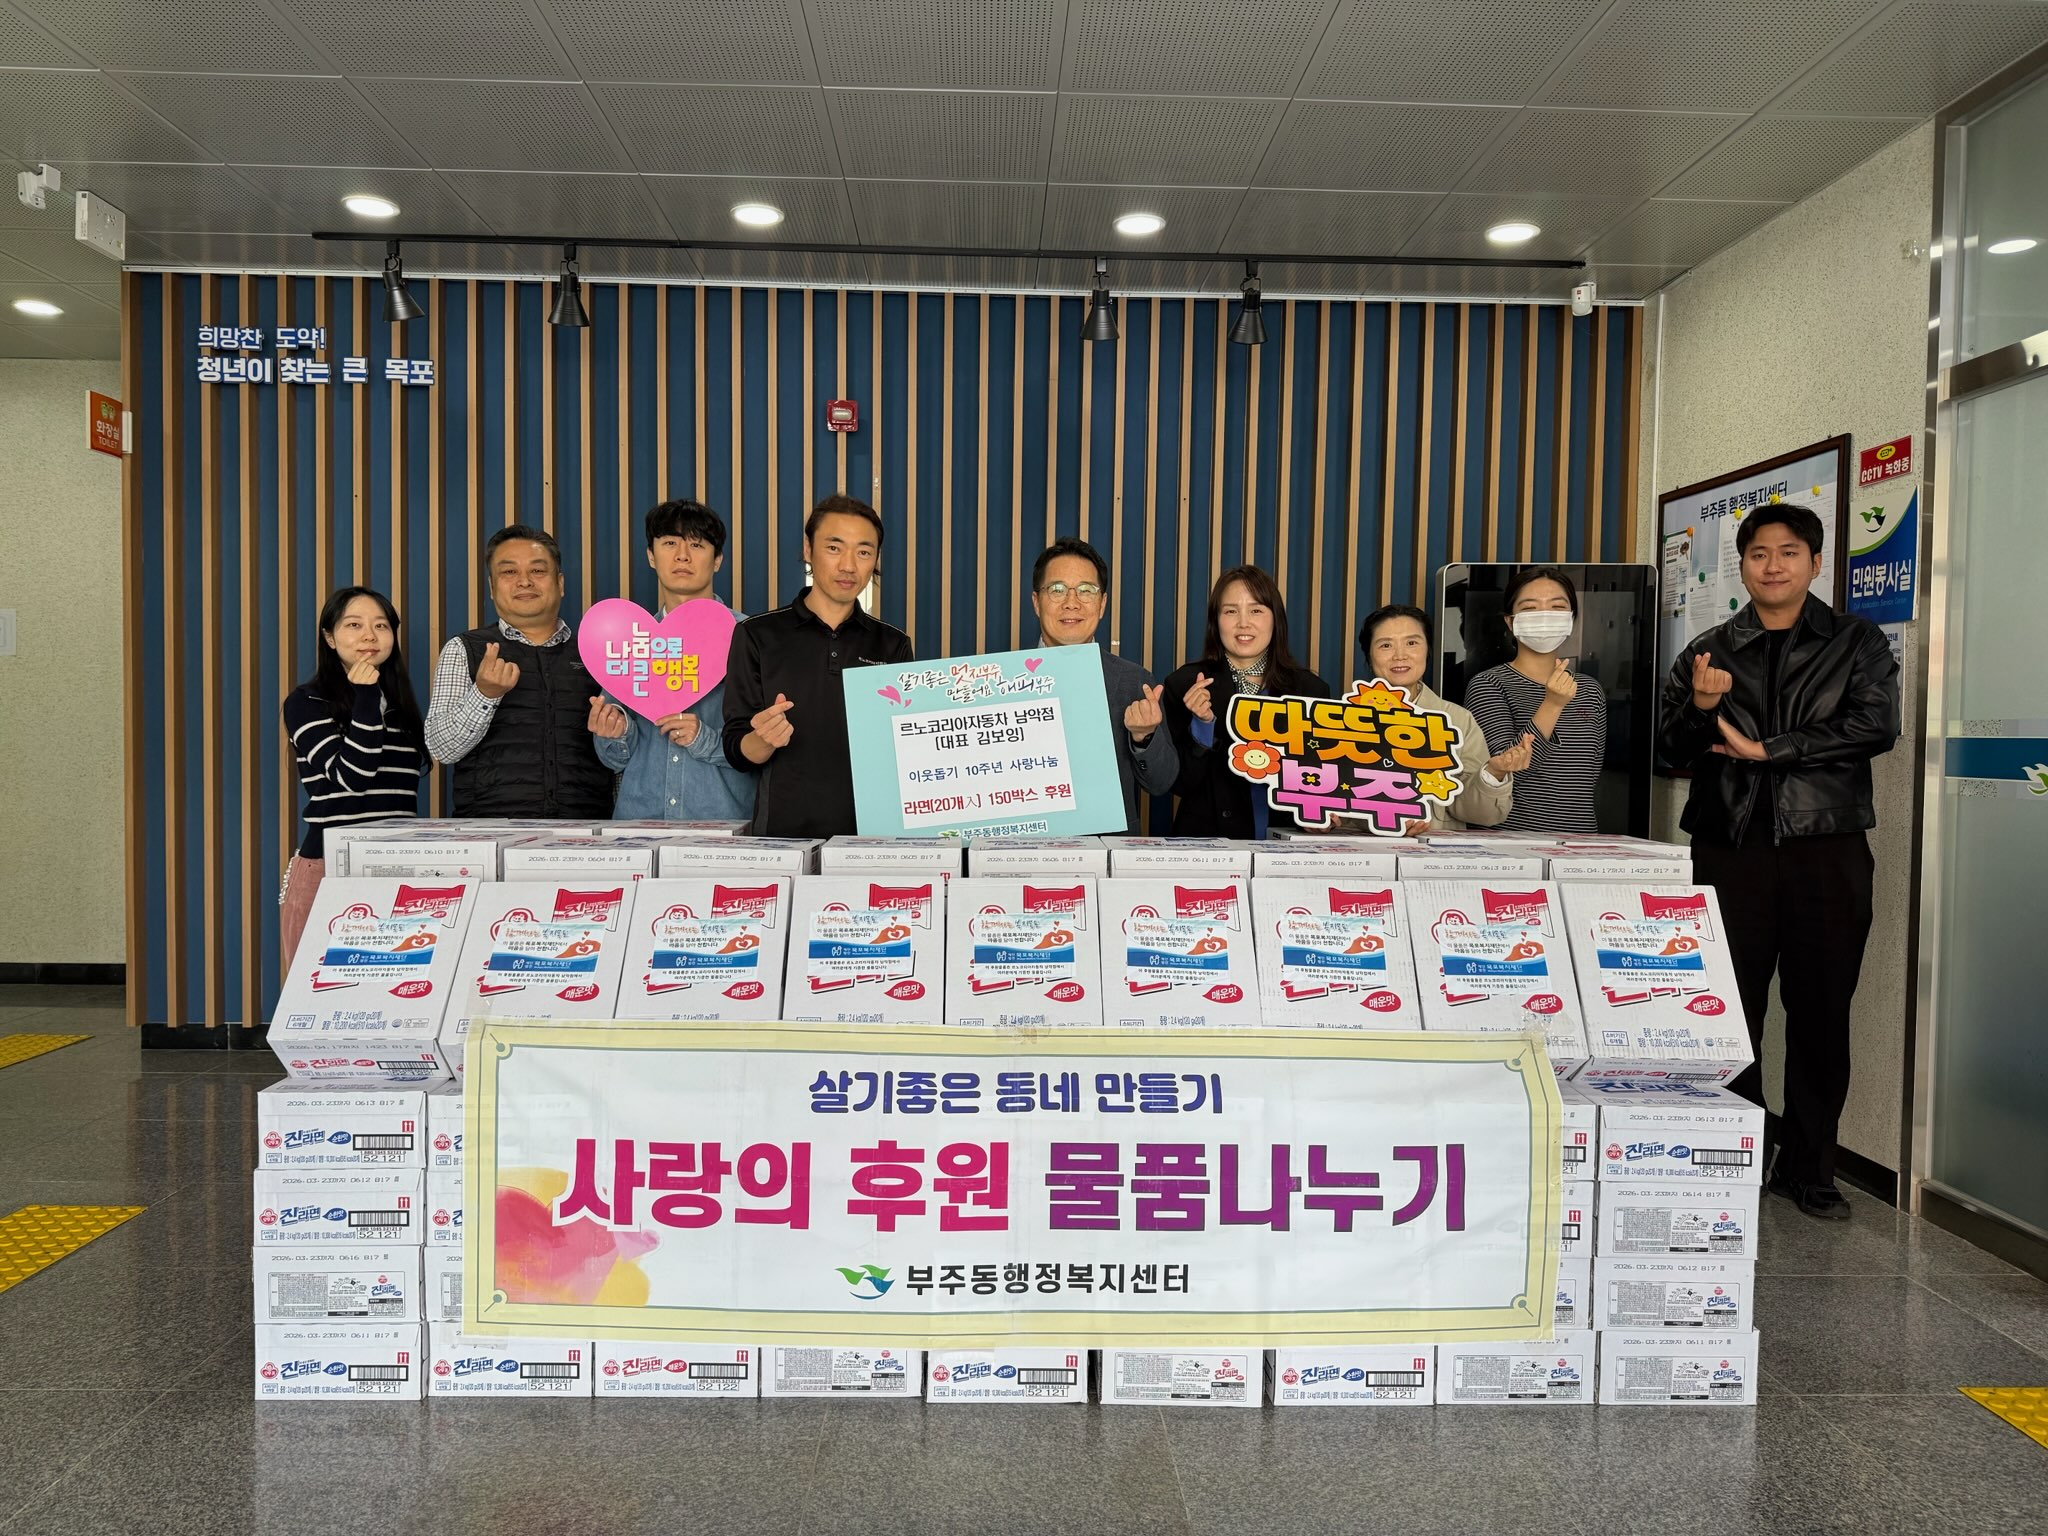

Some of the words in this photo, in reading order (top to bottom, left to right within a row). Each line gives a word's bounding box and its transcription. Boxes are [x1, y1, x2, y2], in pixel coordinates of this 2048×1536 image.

[198, 326, 262, 350] 희망찬
[276, 326, 326, 350] 도약!
[197, 356, 272, 384] 청년이
[280, 357, 331, 385] 찾는
[342, 357, 368, 384] 큰
[384, 358, 434, 386] 목포
[96, 420, 120, 440] 화장실
[97, 435, 118, 449] TOILET
[1861, 466, 1883, 483] CCTV
[1885, 456, 1910, 476] 녹화중
[1700, 498, 1727, 522] 부주동
[1729, 480, 1788, 514] 행정복지센터
[1852, 559, 1912, 598] 민원봉사실
[606, 622, 683, 659] 나눔으로
[652, 655, 699, 693] 행복
[899, 671, 949, 691] 살기좋은
[947, 685, 993, 702] 만들어요
[900, 711, 1008, 737] 르노코리아자동차
[1014, 706, 1055, 724] 남악점
[1234, 699, 1455, 770] 따뜻한
[909, 766, 958, 783] 이웃돕기
[965, 761, 1003, 777] 10주년
[1010, 755, 1059, 773] 사랑나눔
[989, 788, 1038, 806] 150박스
[1045, 783, 1072, 799] 후원
[1276, 759, 1422, 829] 부주
[963, 821, 1047, 839] 부주동행정복지센터
[398, 980, 428, 996] 매운맛
[565, 984, 594, 999] 매운맛
[731, 983, 760, 997] 매운맛
[893, 984, 920, 998] 매운맛
[1053, 985, 1079, 999] 매운맛
[1211, 986, 1238, 1000] 매운맛
[1368, 994, 1396, 1008] 매운맛
[1530, 996, 1557, 1011] 매운맛
[1693, 998, 1720, 1013] 매운맛
[810, 1071, 981, 1114] 살기좋은
[996, 1072, 1081, 1114] 동네
[1095, 1073, 1223, 1114] 만들기
[284, 1129, 325, 1149] 진라면
[331, 1134, 349, 1143] 순한맛
[363, 1154, 378, 1162] 52
[382, 1154, 402, 1162] 121
[1625, 1143, 1665, 1161] 진라면
[1671, 1148, 1687, 1157] 순한맛
[1720, 1170, 1740, 1178] 121
[560, 1139, 811, 1230] 사랑의
[847, 1140, 1010, 1232] 후원
[1045, 1143, 1466, 1232] 물품나누기
[280, 1206, 320, 1226] 진라면
[327, 1211, 344, 1220] 순한맛
[359, 1231, 374, 1239] 52
[379, 1231, 397, 1239] 121
[906, 1262, 1190, 1295] 부주동행정복지센터
[281, 1360, 321, 1380] 진라면
[328, 1364, 345, 1374] 순한맛
[453, 1358, 493, 1377] 진라면
[500, 1361, 516, 1371] 순한맛
[622, 1358, 662, 1377] 진라면
[668, 1362, 685, 1372] 매운맛
[952, 1363, 991, 1383] 진라면
[998, 1368, 1014, 1377] 순한맛
[1301, 1366, 1340, 1386] 진라면
[1346, 1371, 1363, 1380] 순한맛
[359, 1385, 373, 1393] 52
[377, 1385, 397, 1393] 121
[1376, 1391, 1390, 1399] 52
[1394, 1391, 1412, 1399] 121
